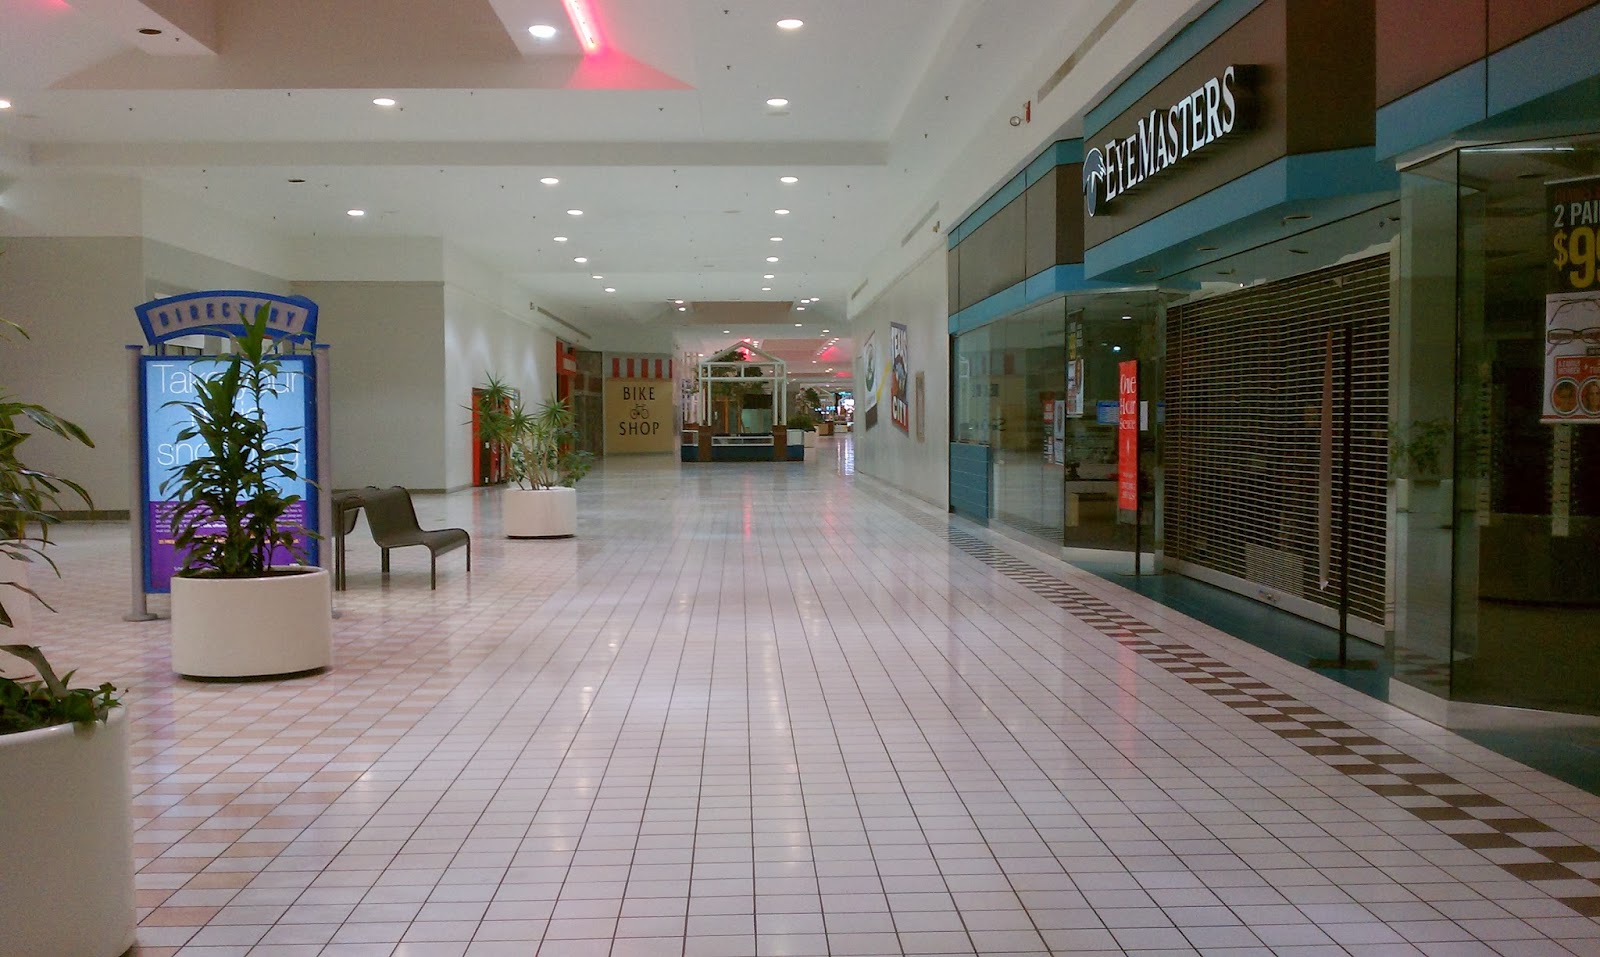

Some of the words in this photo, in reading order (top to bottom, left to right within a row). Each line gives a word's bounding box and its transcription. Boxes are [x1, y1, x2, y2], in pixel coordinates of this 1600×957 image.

[1554, 203, 1565, 228] 2
[1570, 199, 1600, 226] PAI
[1553, 226, 1600, 288] $9
[158, 301, 297, 328] DIRECTORY
[623, 386, 655, 401] BIKE
[1120, 374, 1136, 394] One
[619, 421, 660, 436] SHOP
